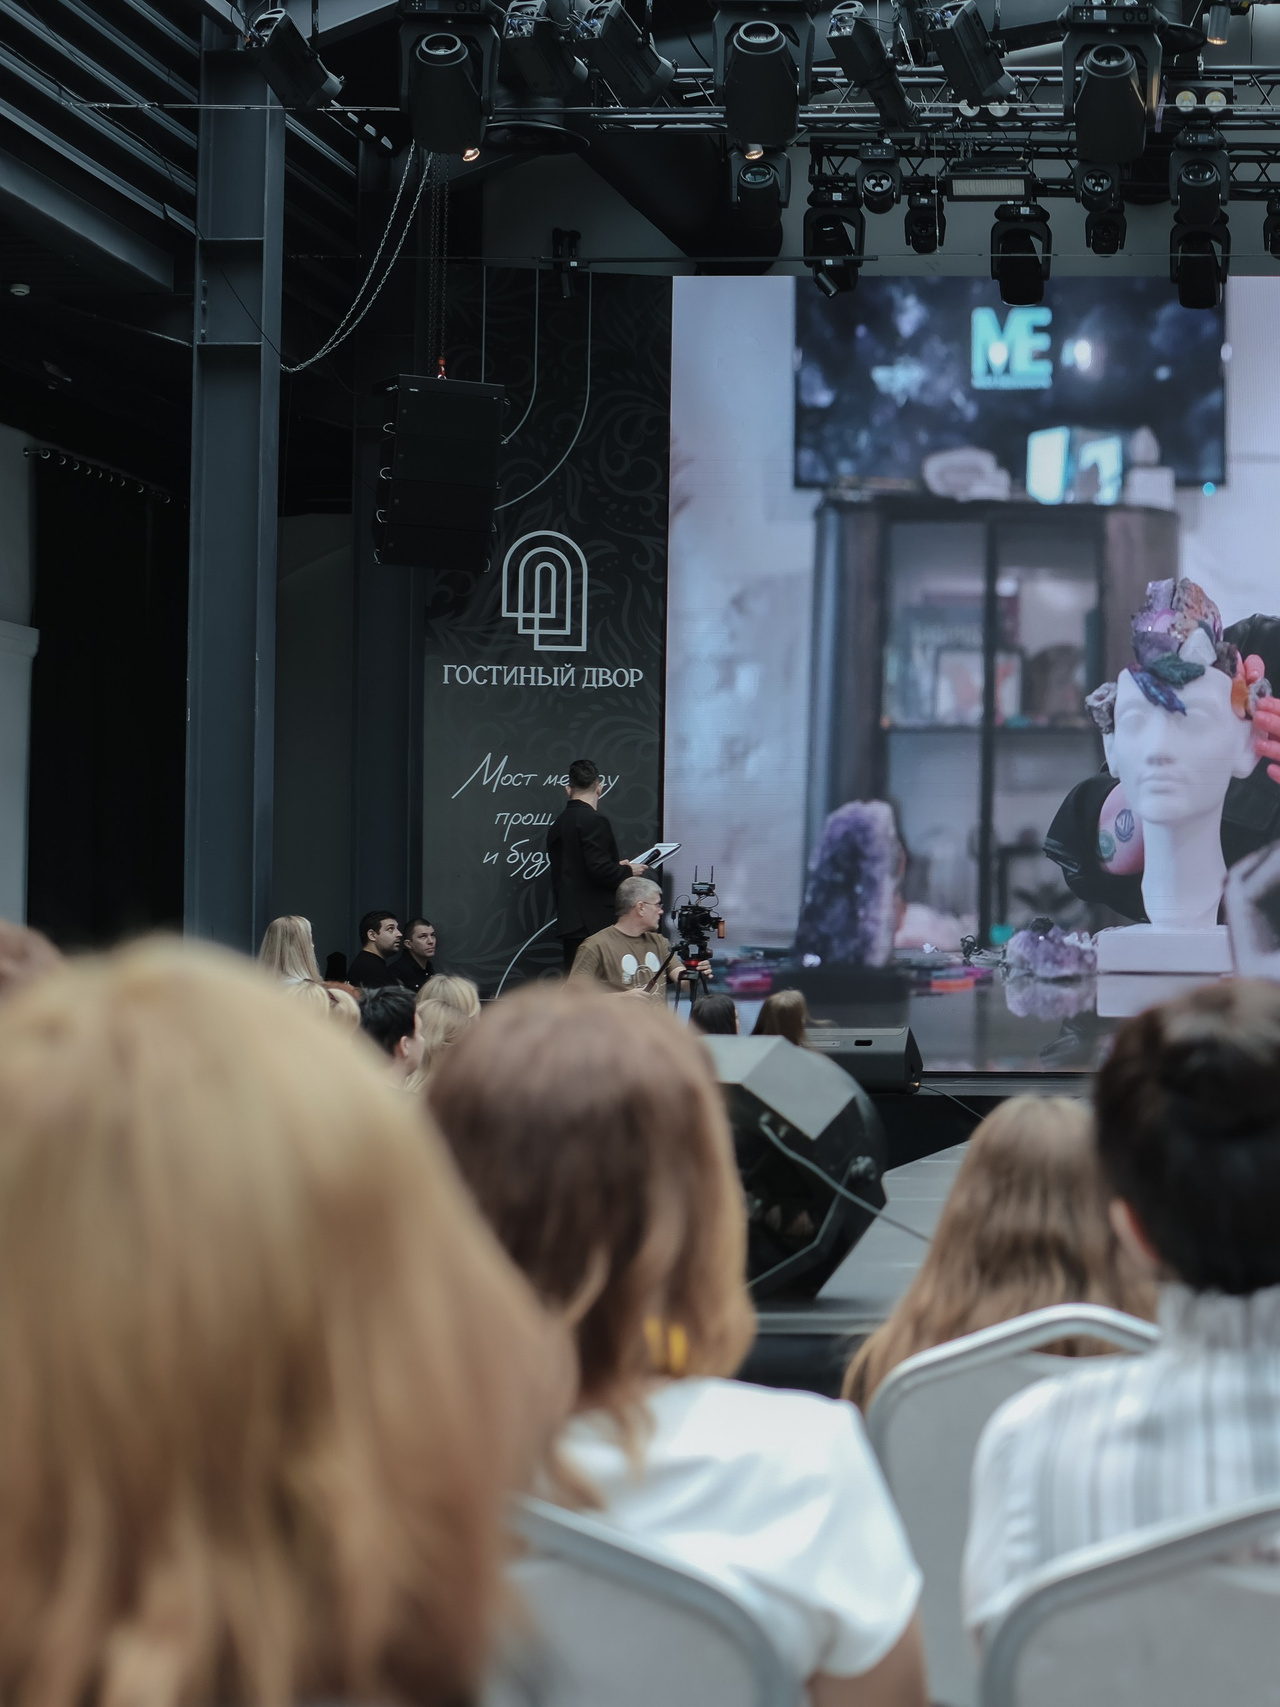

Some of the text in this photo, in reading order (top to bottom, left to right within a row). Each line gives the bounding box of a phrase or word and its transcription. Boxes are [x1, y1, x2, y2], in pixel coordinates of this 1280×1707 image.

[443, 663, 644, 690] ГОСТИНЫЙ ДВОР
[451, 752, 621, 801] Мост меу
[494, 811, 556, 843] прош
[483, 838, 552, 880] и буду
